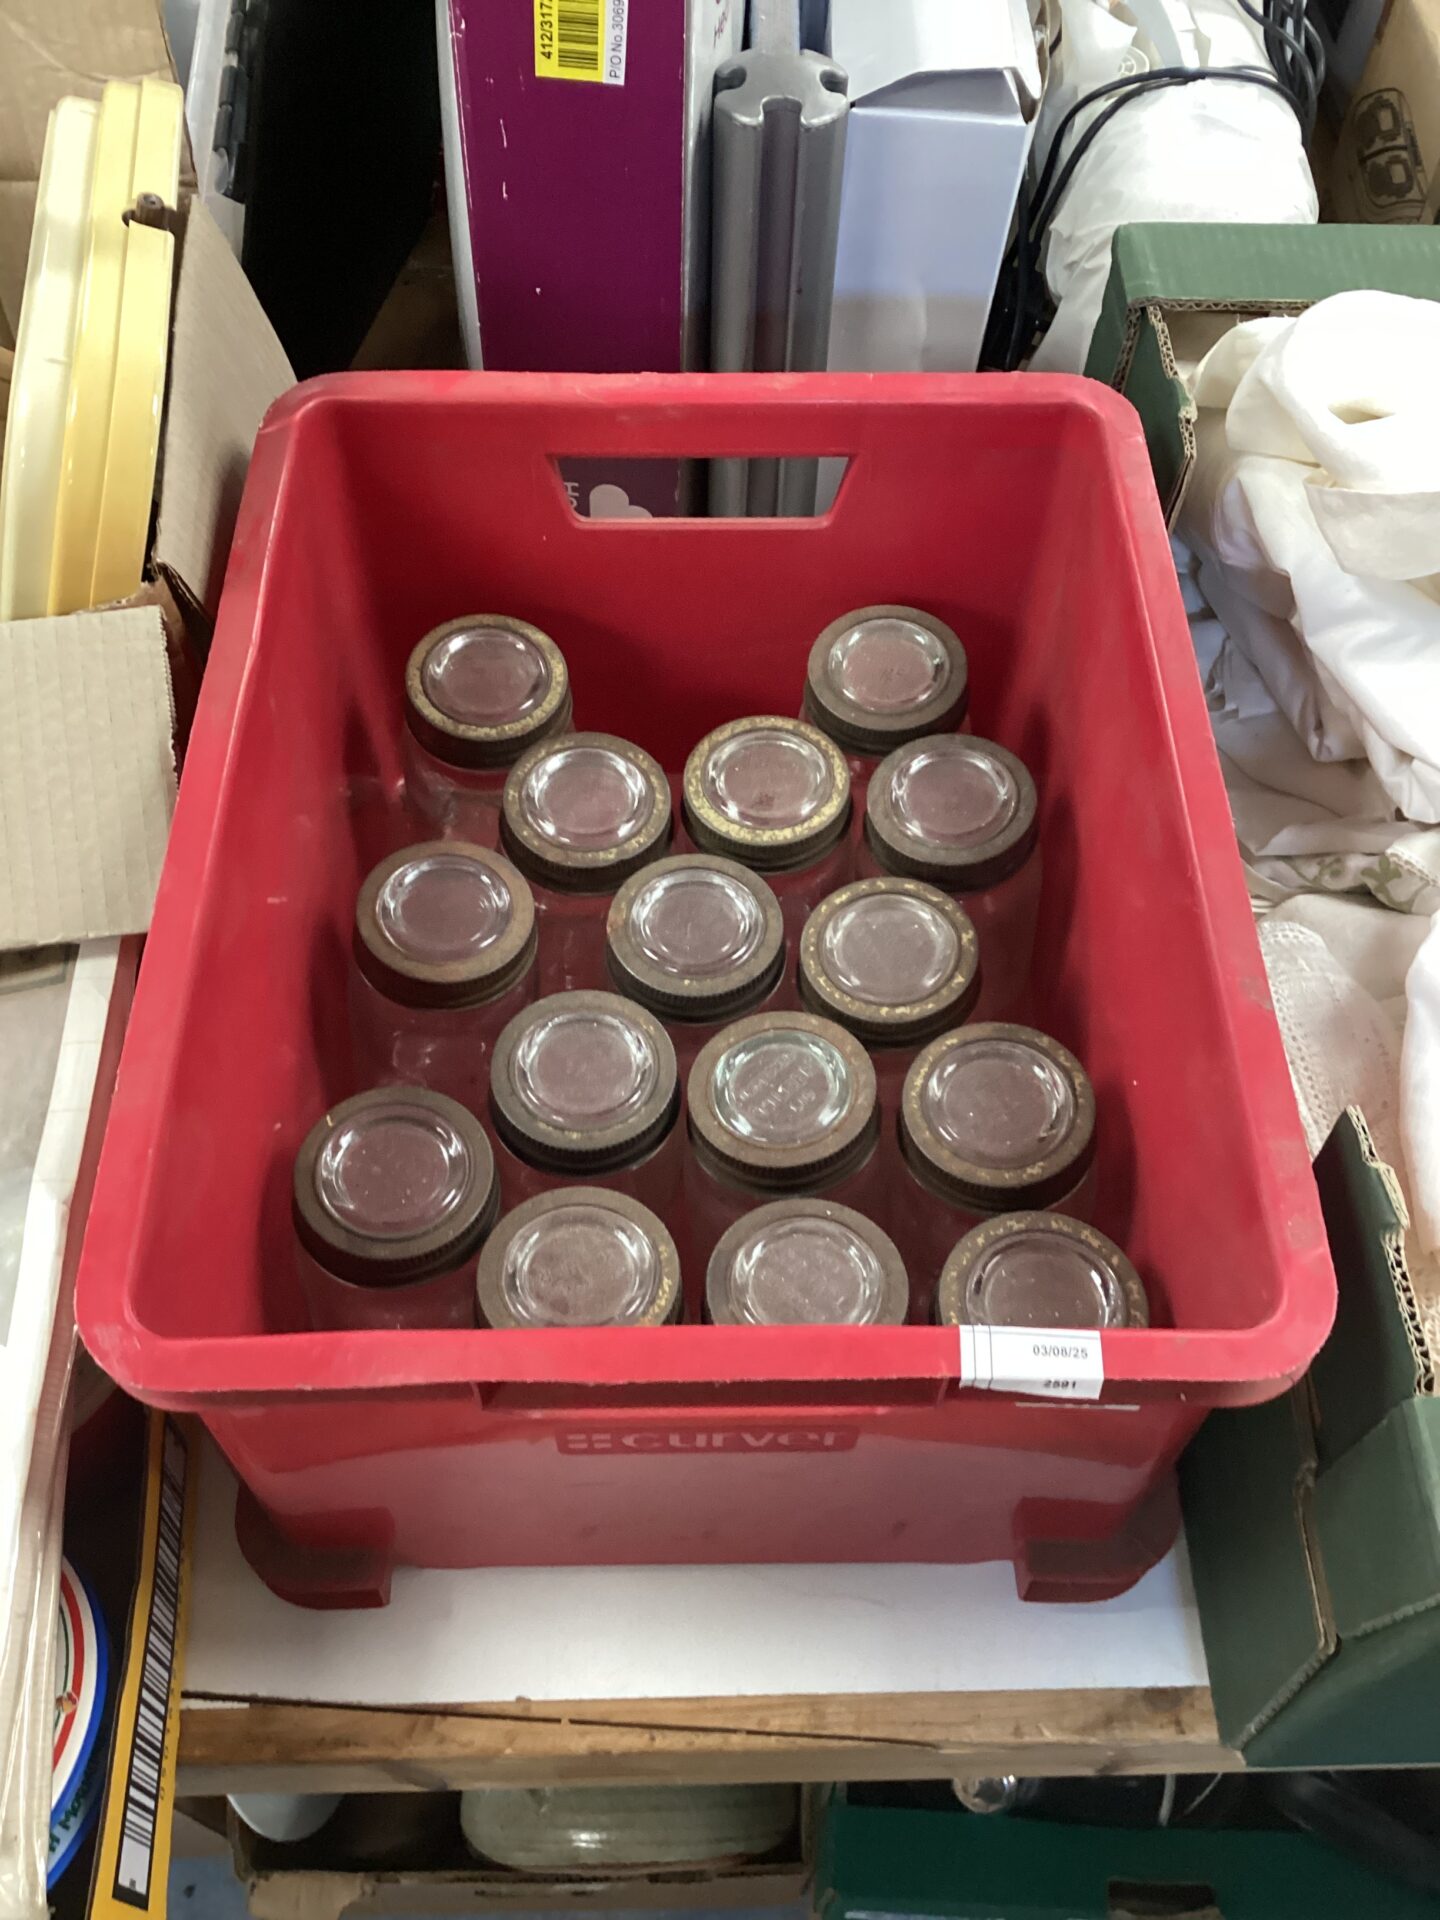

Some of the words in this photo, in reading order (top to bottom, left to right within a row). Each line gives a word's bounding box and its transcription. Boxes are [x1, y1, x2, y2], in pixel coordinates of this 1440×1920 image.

[539, 0, 553, 60] 412/317
[609, 55, 622, 79] P/O
[1033, 1344, 1088, 1360] 03/08/25
[621, 1432, 843, 1448] curver
